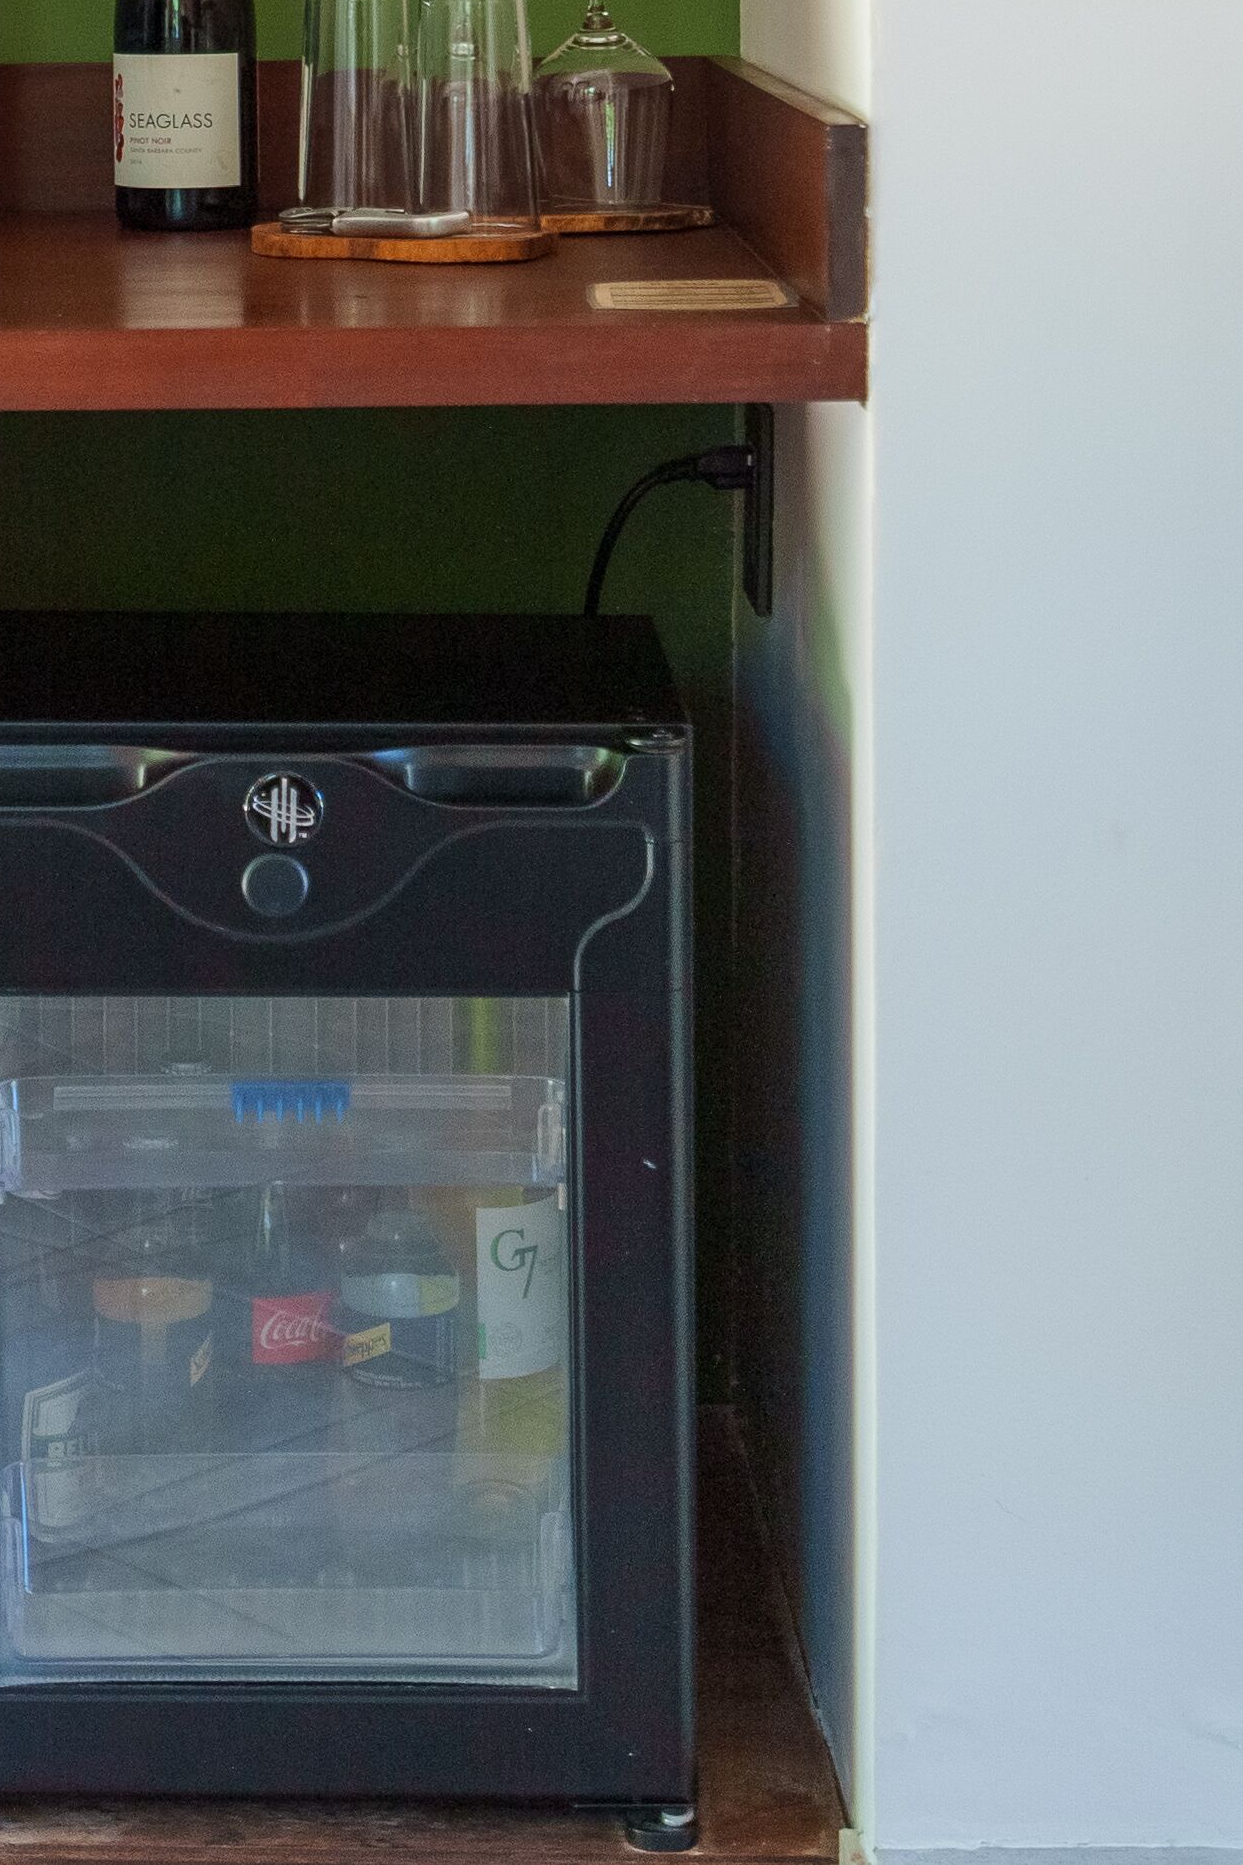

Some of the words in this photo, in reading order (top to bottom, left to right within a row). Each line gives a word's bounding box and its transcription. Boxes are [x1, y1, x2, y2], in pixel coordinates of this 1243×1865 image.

[129, 112, 213, 129] SEAGLASS
[130, 137, 149, 145] PINOT
[151, 137, 172, 145] NOIR
[490, 1228, 539, 1300] G7
